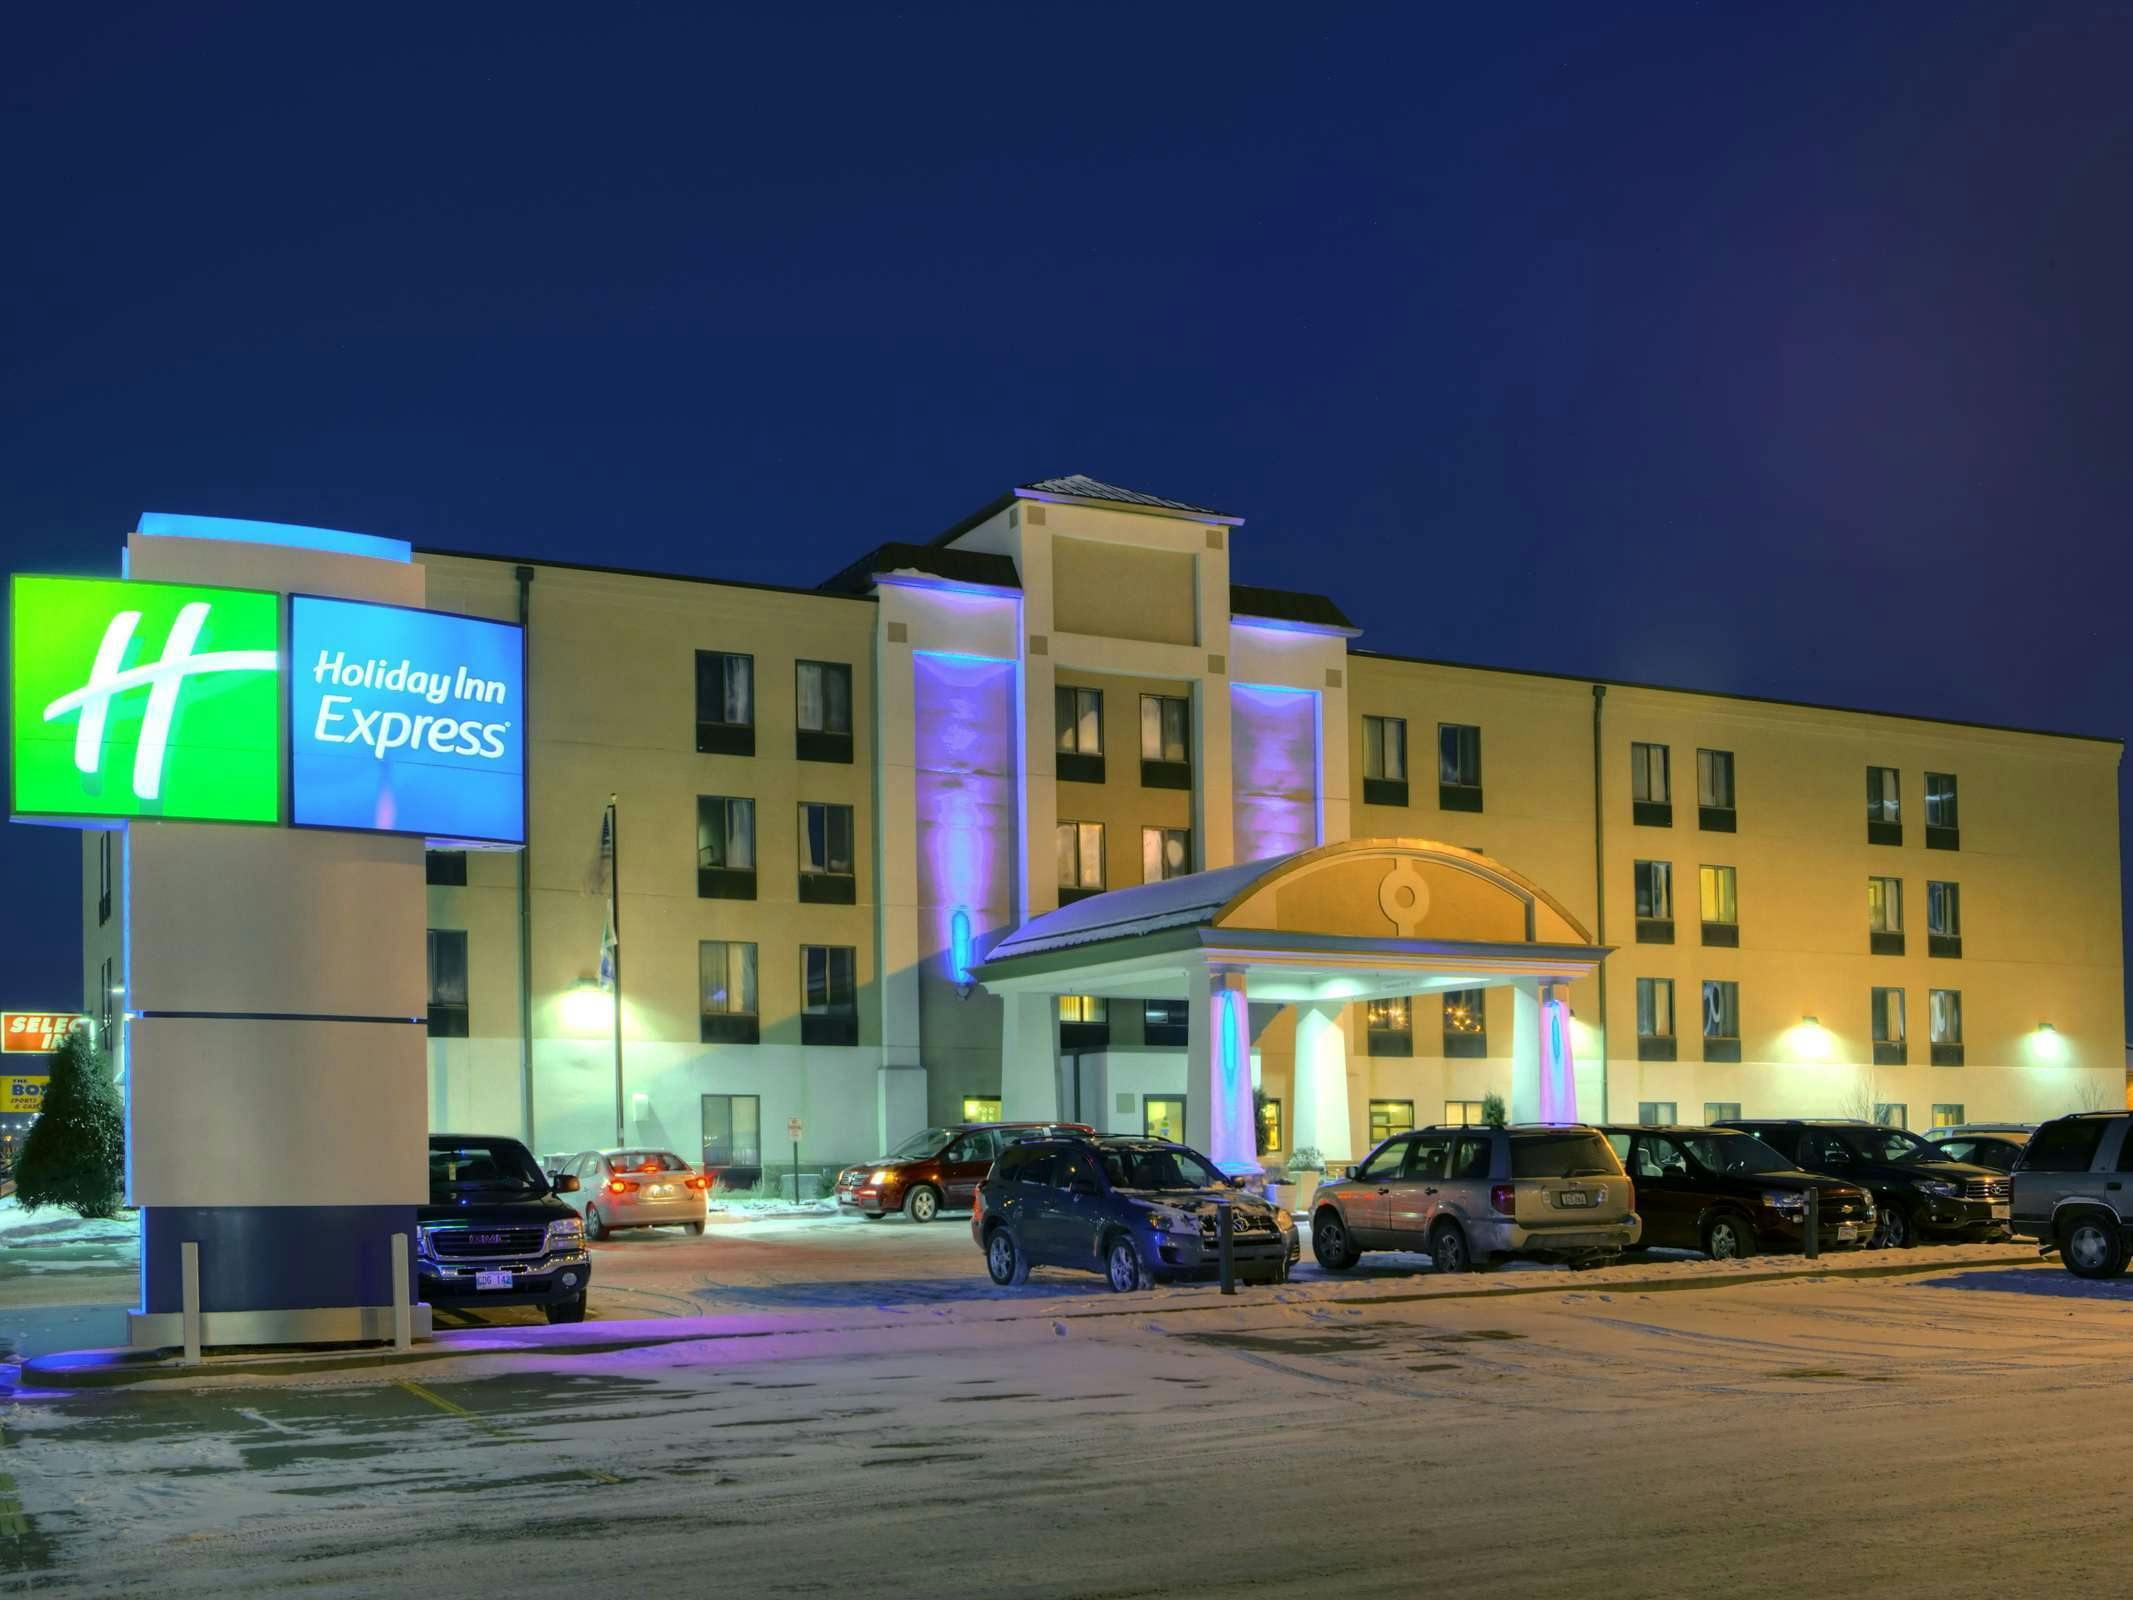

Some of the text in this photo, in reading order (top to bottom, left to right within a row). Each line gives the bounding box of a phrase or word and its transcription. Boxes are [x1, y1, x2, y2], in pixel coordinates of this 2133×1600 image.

[313, 650, 506, 704] Holiday Inn
[314, 695, 506, 759] Express
[10, 1016, 82, 1033] SELEC
